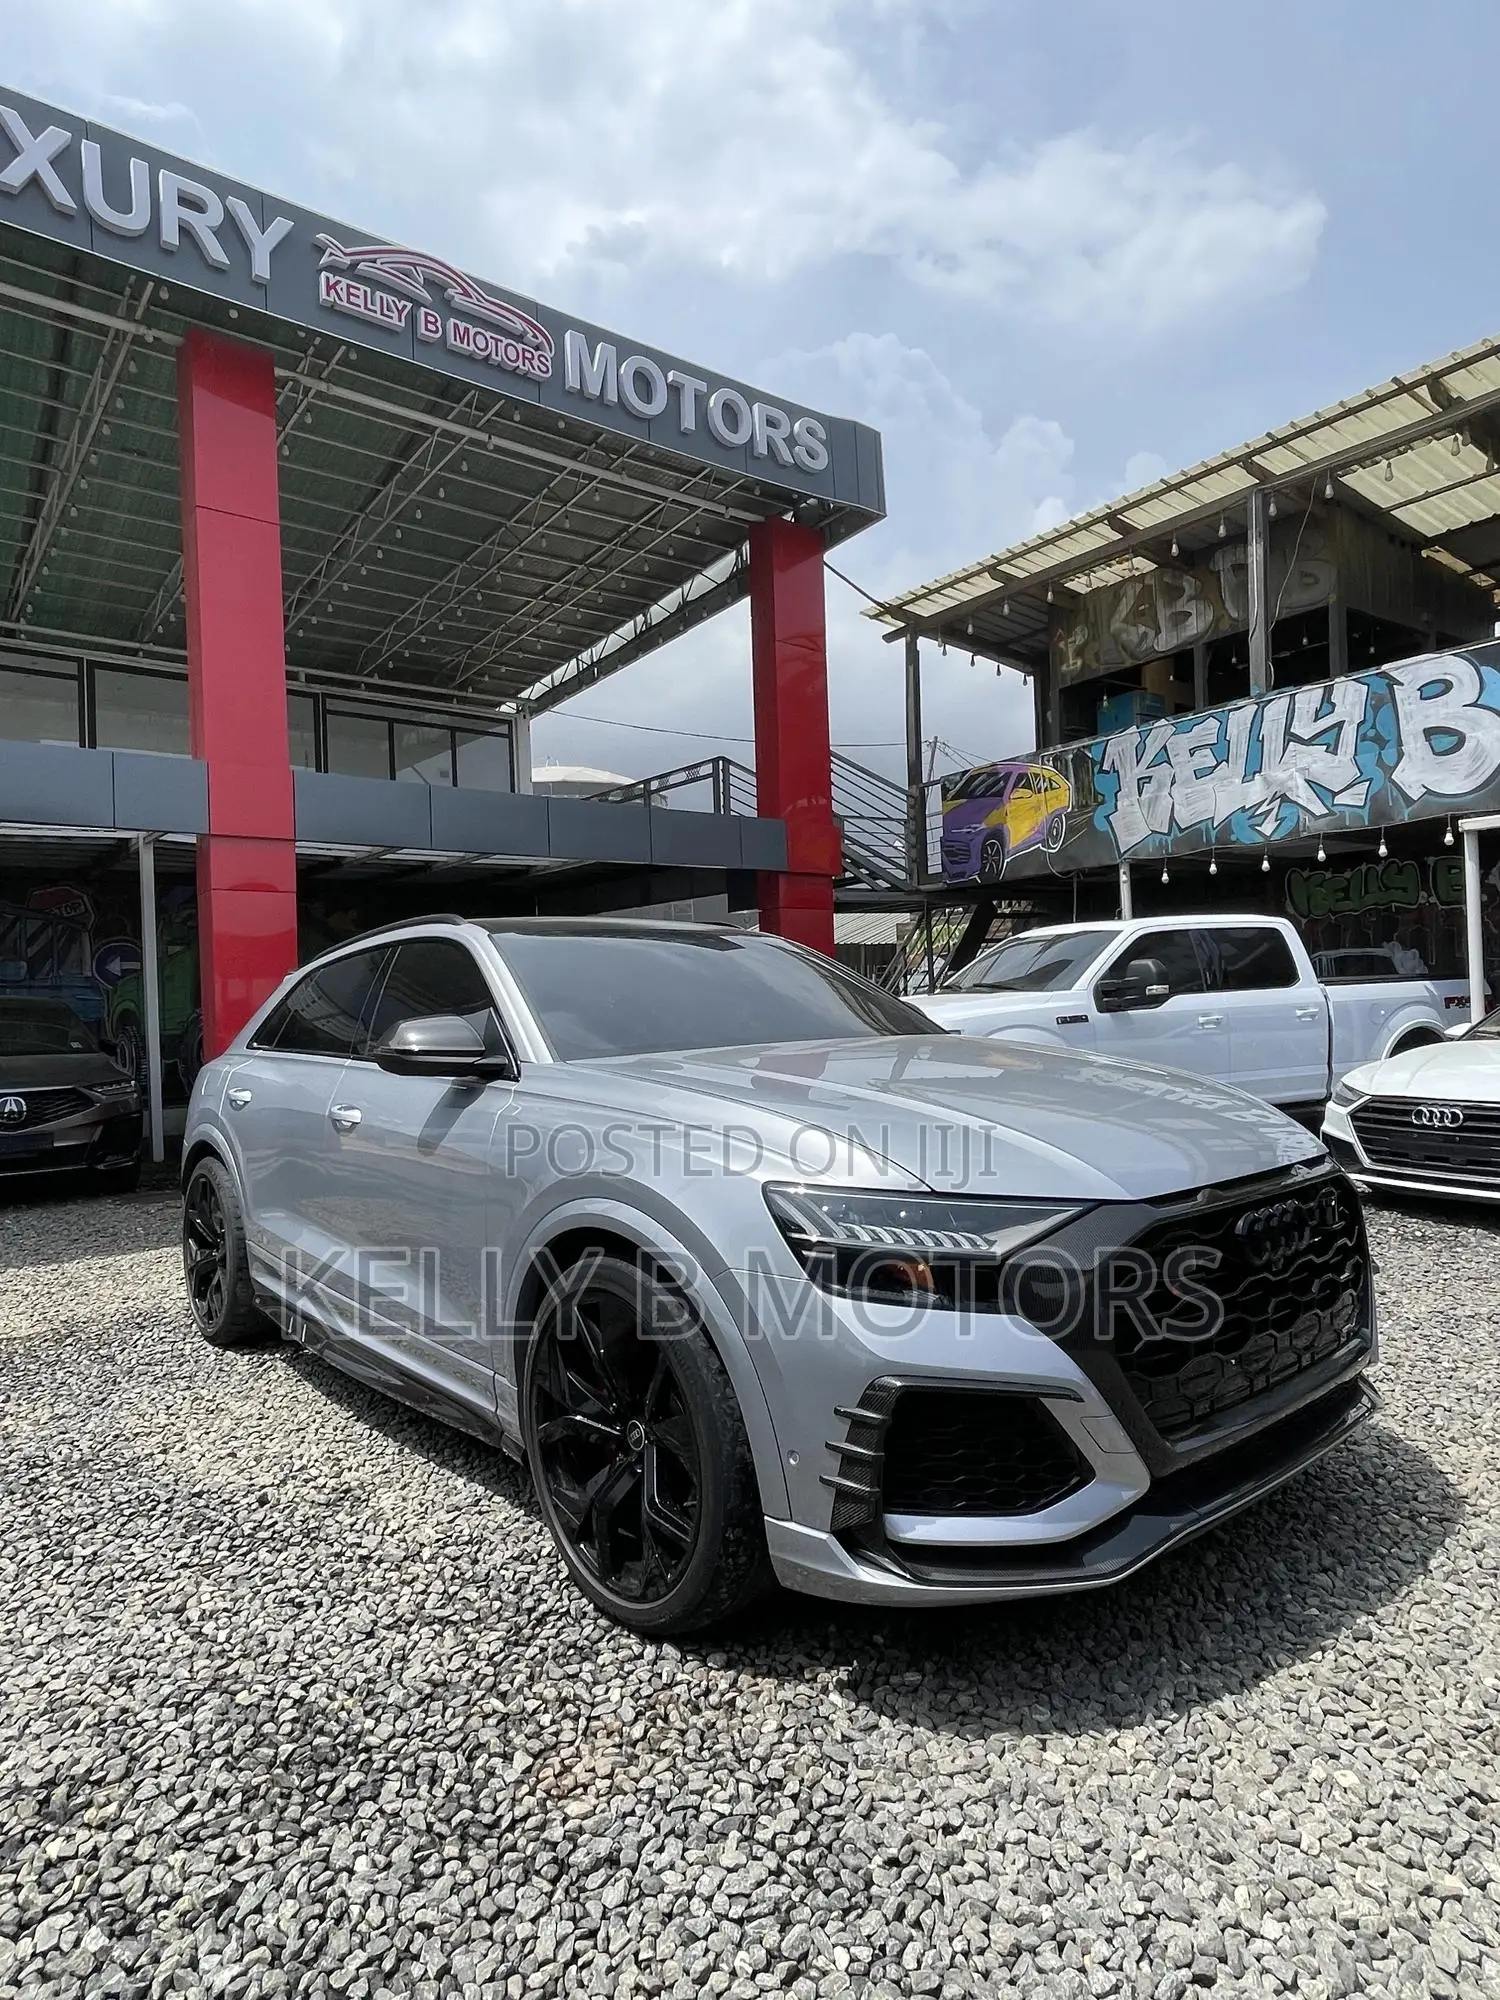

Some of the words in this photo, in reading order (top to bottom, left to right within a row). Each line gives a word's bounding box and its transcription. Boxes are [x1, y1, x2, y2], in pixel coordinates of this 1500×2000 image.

[0, 105, 295, 284] XURY
[321, 271, 413, 331] KELLY
[417, 306, 442, 343] B
[447, 317, 552, 382] MOTORS
[564, 329, 829, 474] MOTORS
[1102, 678, 1371, 856] KELLY
[1382, 653, 1500, 801] B
[1285, 858, 1421, 920] KELLY
